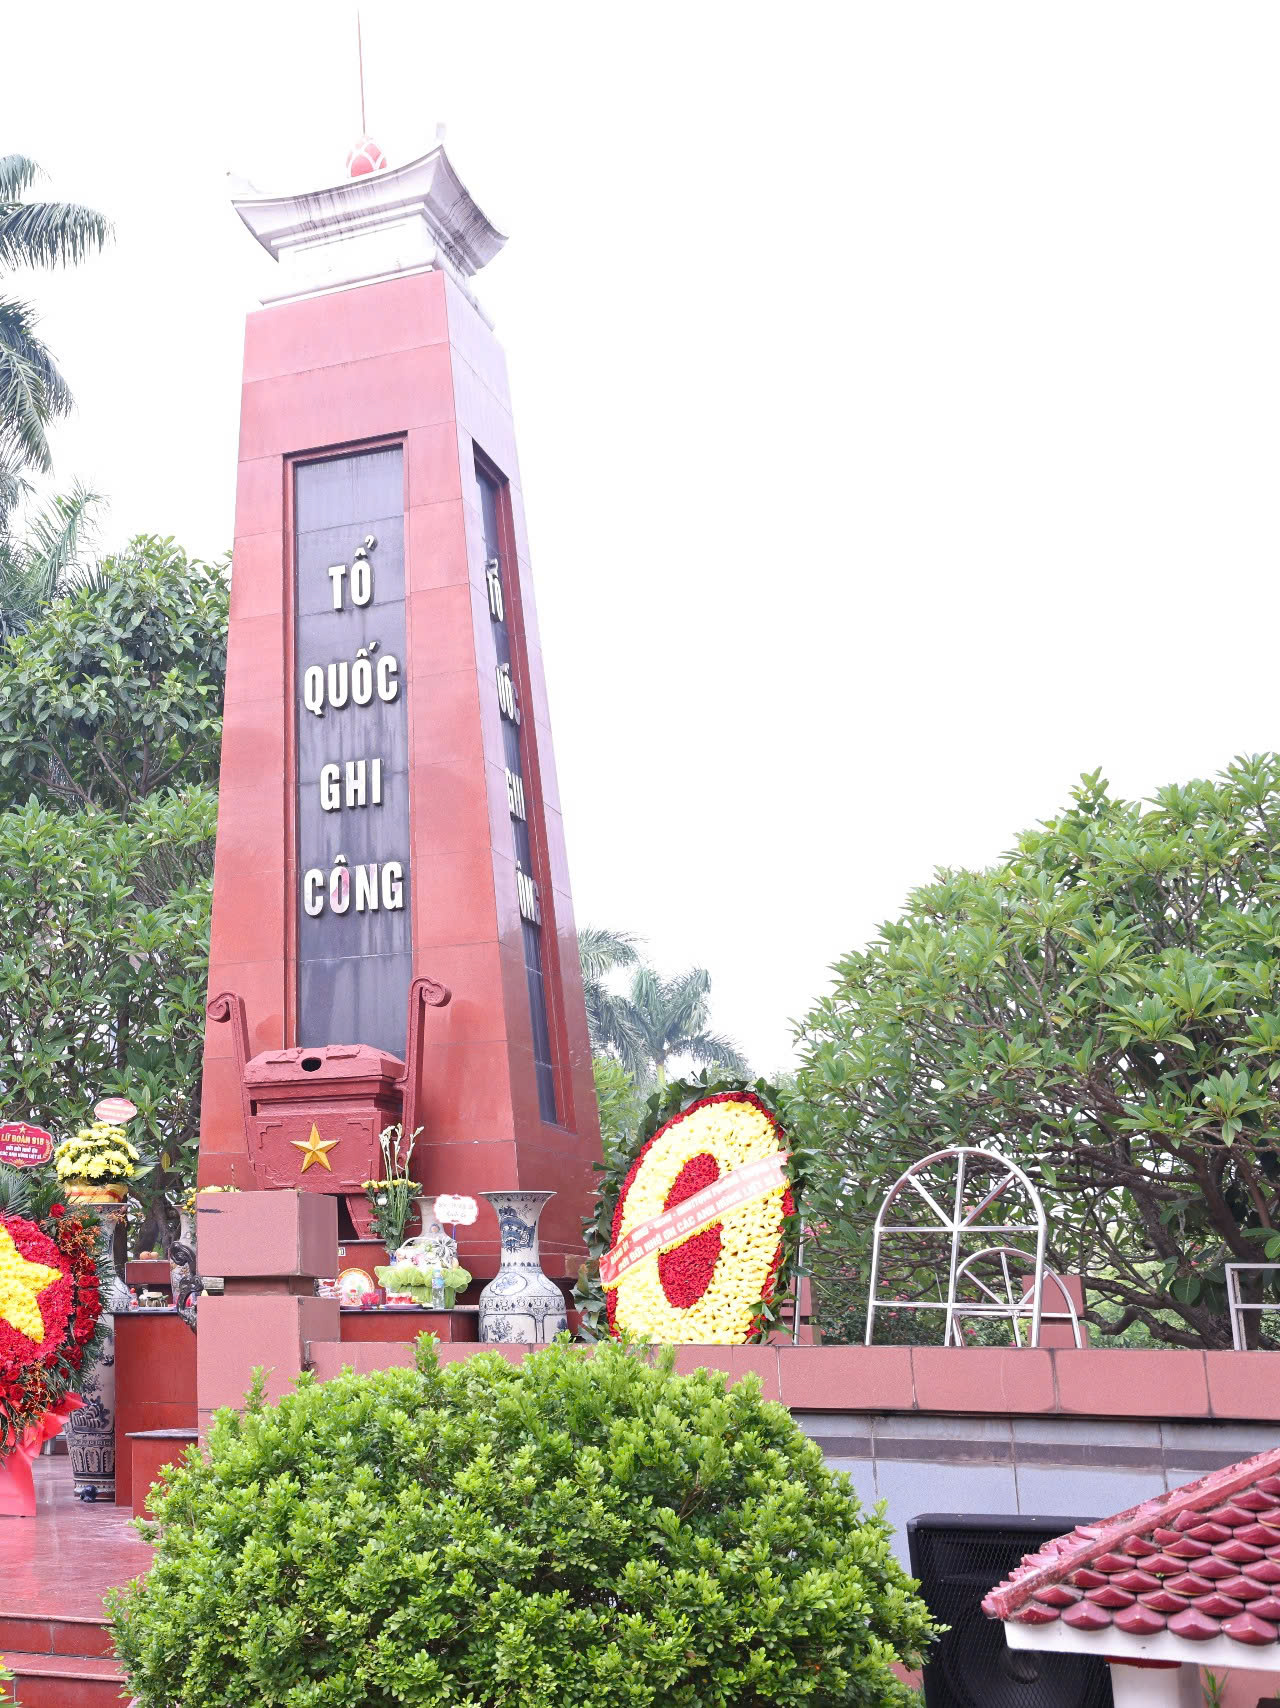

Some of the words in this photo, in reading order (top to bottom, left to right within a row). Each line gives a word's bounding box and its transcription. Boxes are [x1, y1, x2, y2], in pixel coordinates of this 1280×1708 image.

[328, 535, 378, 611] TỔ
[304, 642, 400, 718] QUỐC
[496, 662, 521, 726] UỐC
[320, 758, 384, 812] GHI
[304, 855, 406, 917] CÔNG
[516, 860, 542, 927] ÔNG
